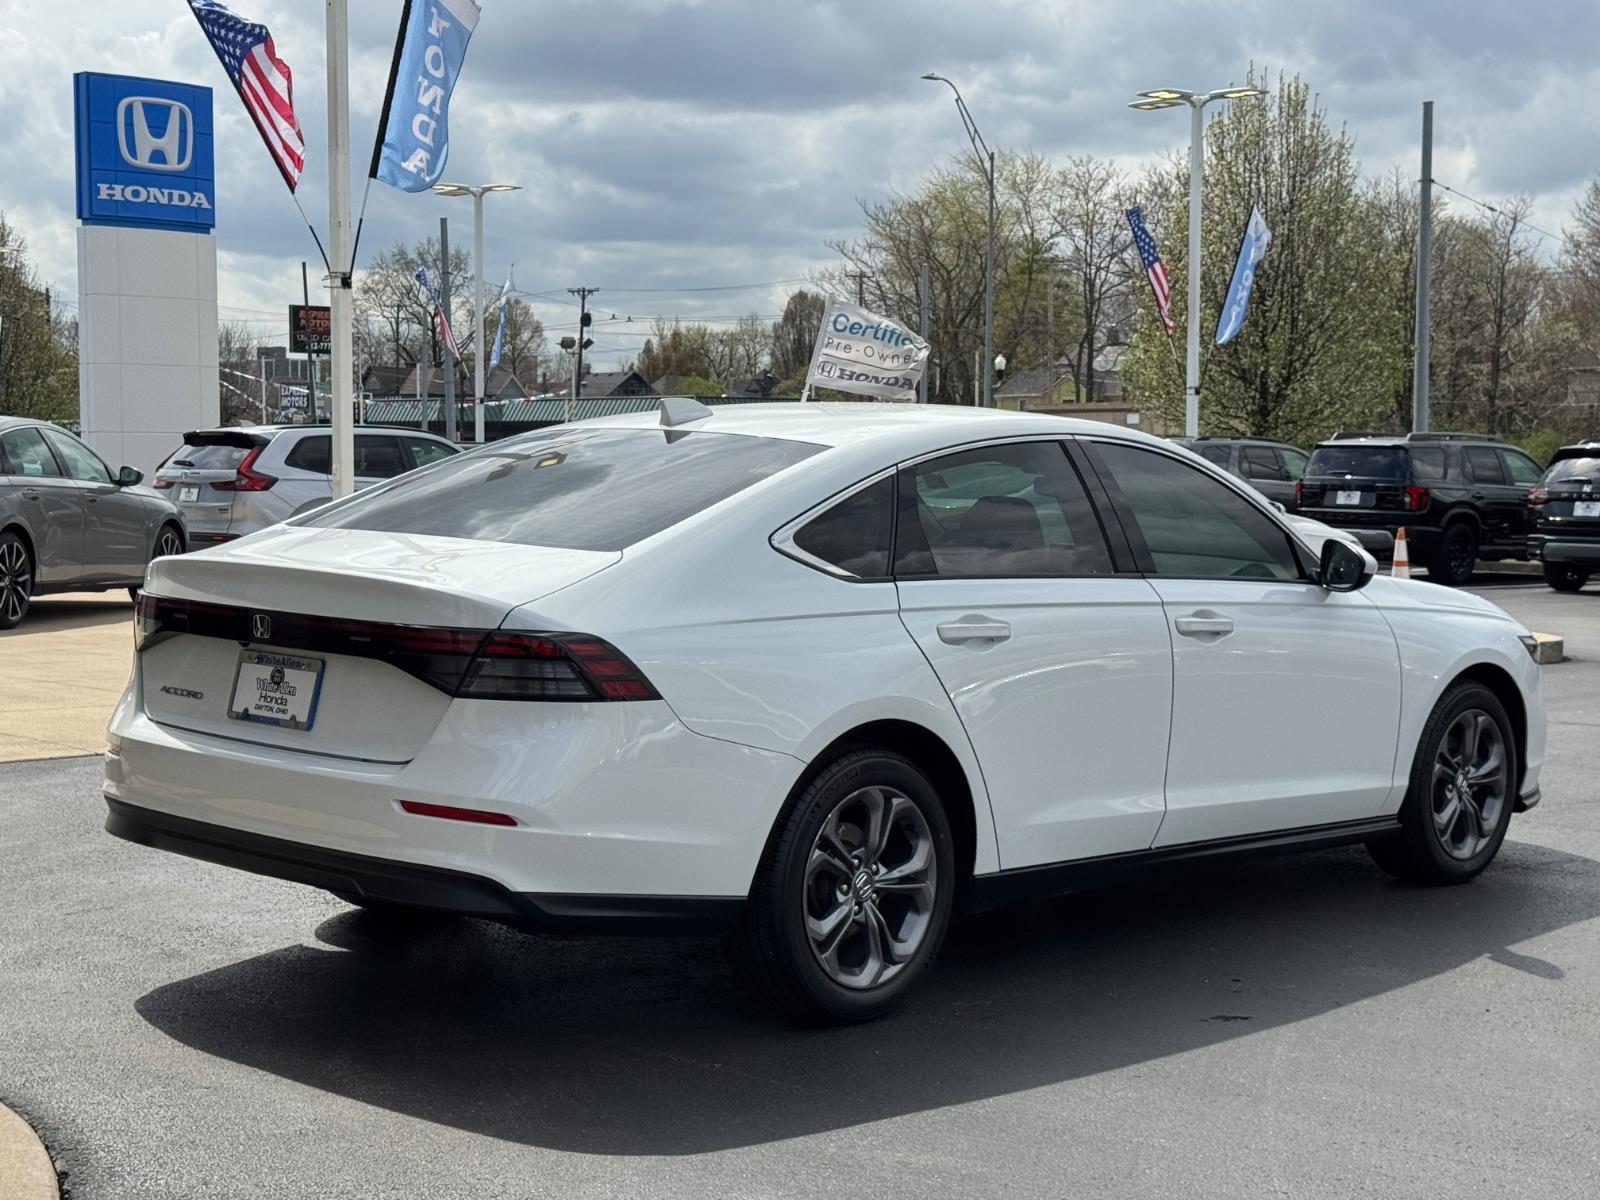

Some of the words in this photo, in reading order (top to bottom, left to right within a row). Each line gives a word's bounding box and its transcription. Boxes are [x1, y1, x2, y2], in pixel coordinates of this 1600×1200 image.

[97, 183, 212, 209] HONDA
[837, 367, 914, 390] HONDA
[281, 396, 308, 408] MOTORS
[160, 685, 204, 700] ACCORD
[259, 691, 288, 706] Honda
[275, 706, 289, 715] OHIO
